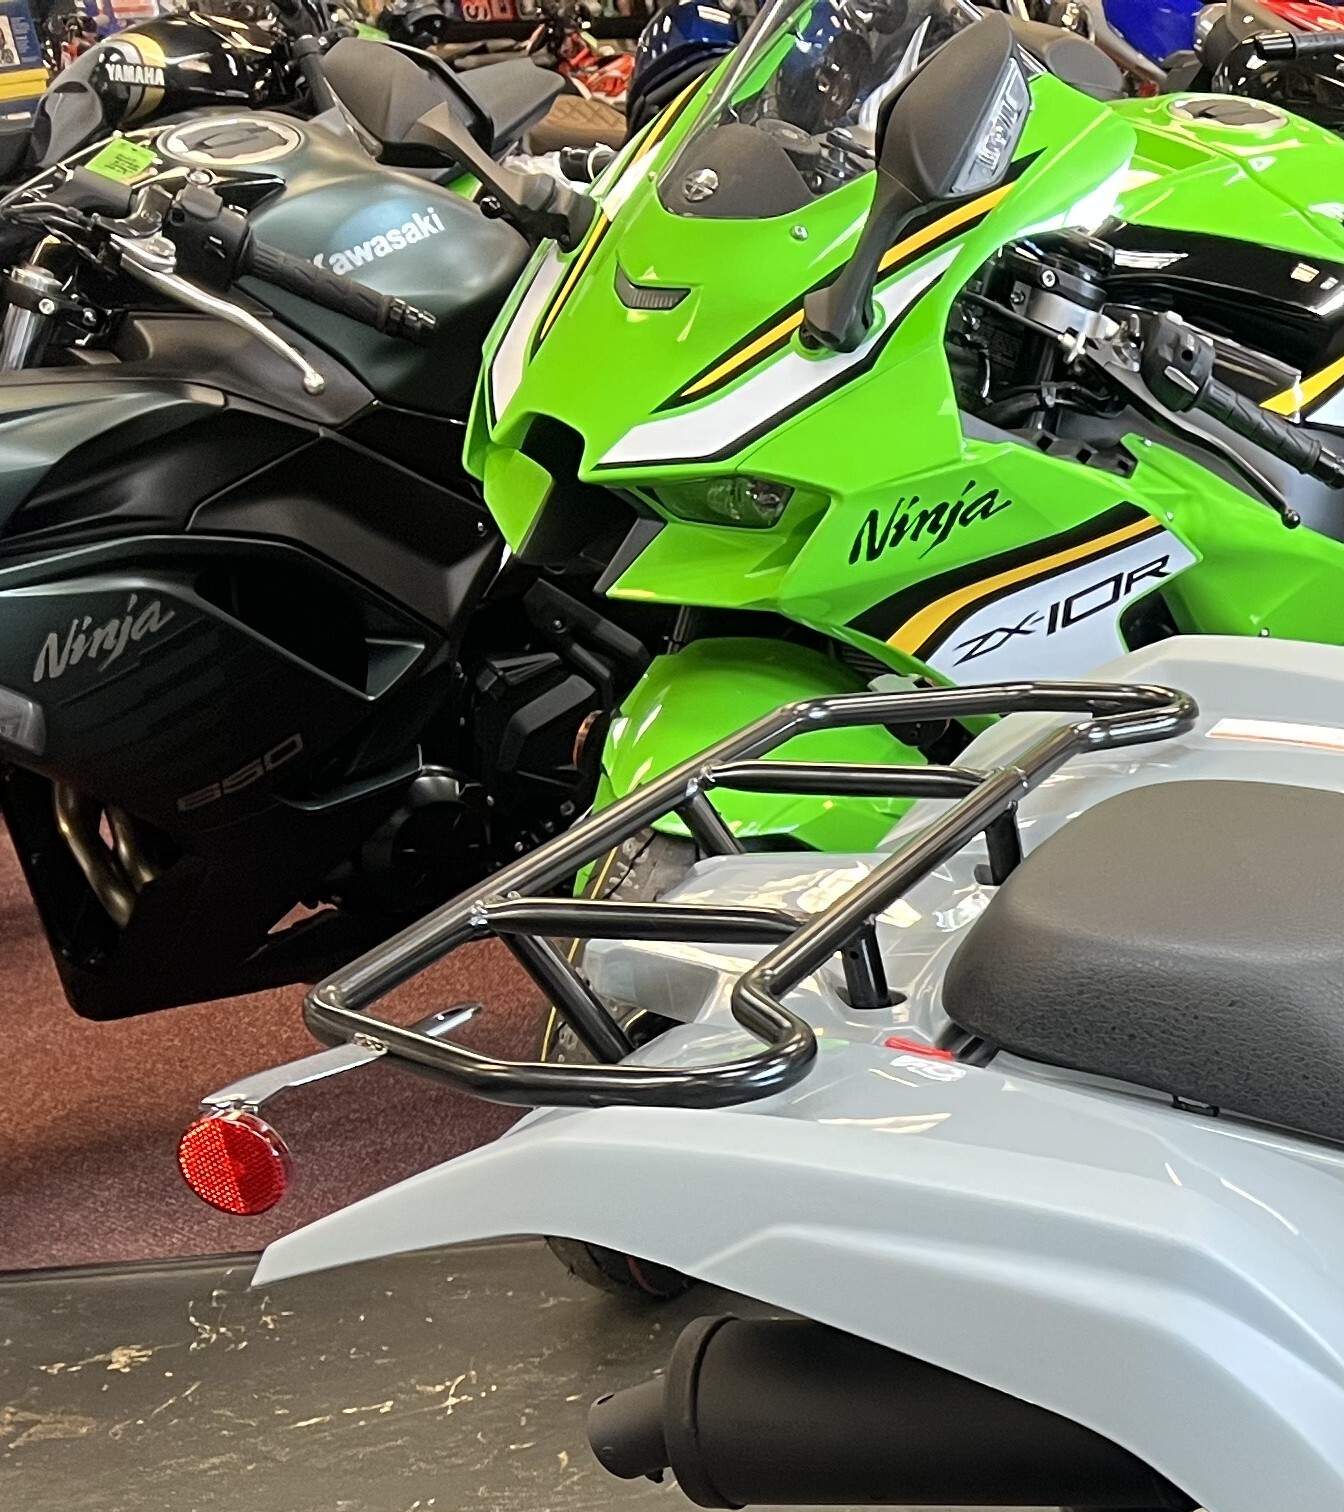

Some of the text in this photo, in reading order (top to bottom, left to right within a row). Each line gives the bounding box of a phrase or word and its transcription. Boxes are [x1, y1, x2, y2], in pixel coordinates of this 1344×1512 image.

[105, 63, 165, 86] YAMAHA
[848, 480, 1012, 565] Ninja
[33, 593, 176, 683] Ninja
[952, 554, 1172, 667] ZX-10R
